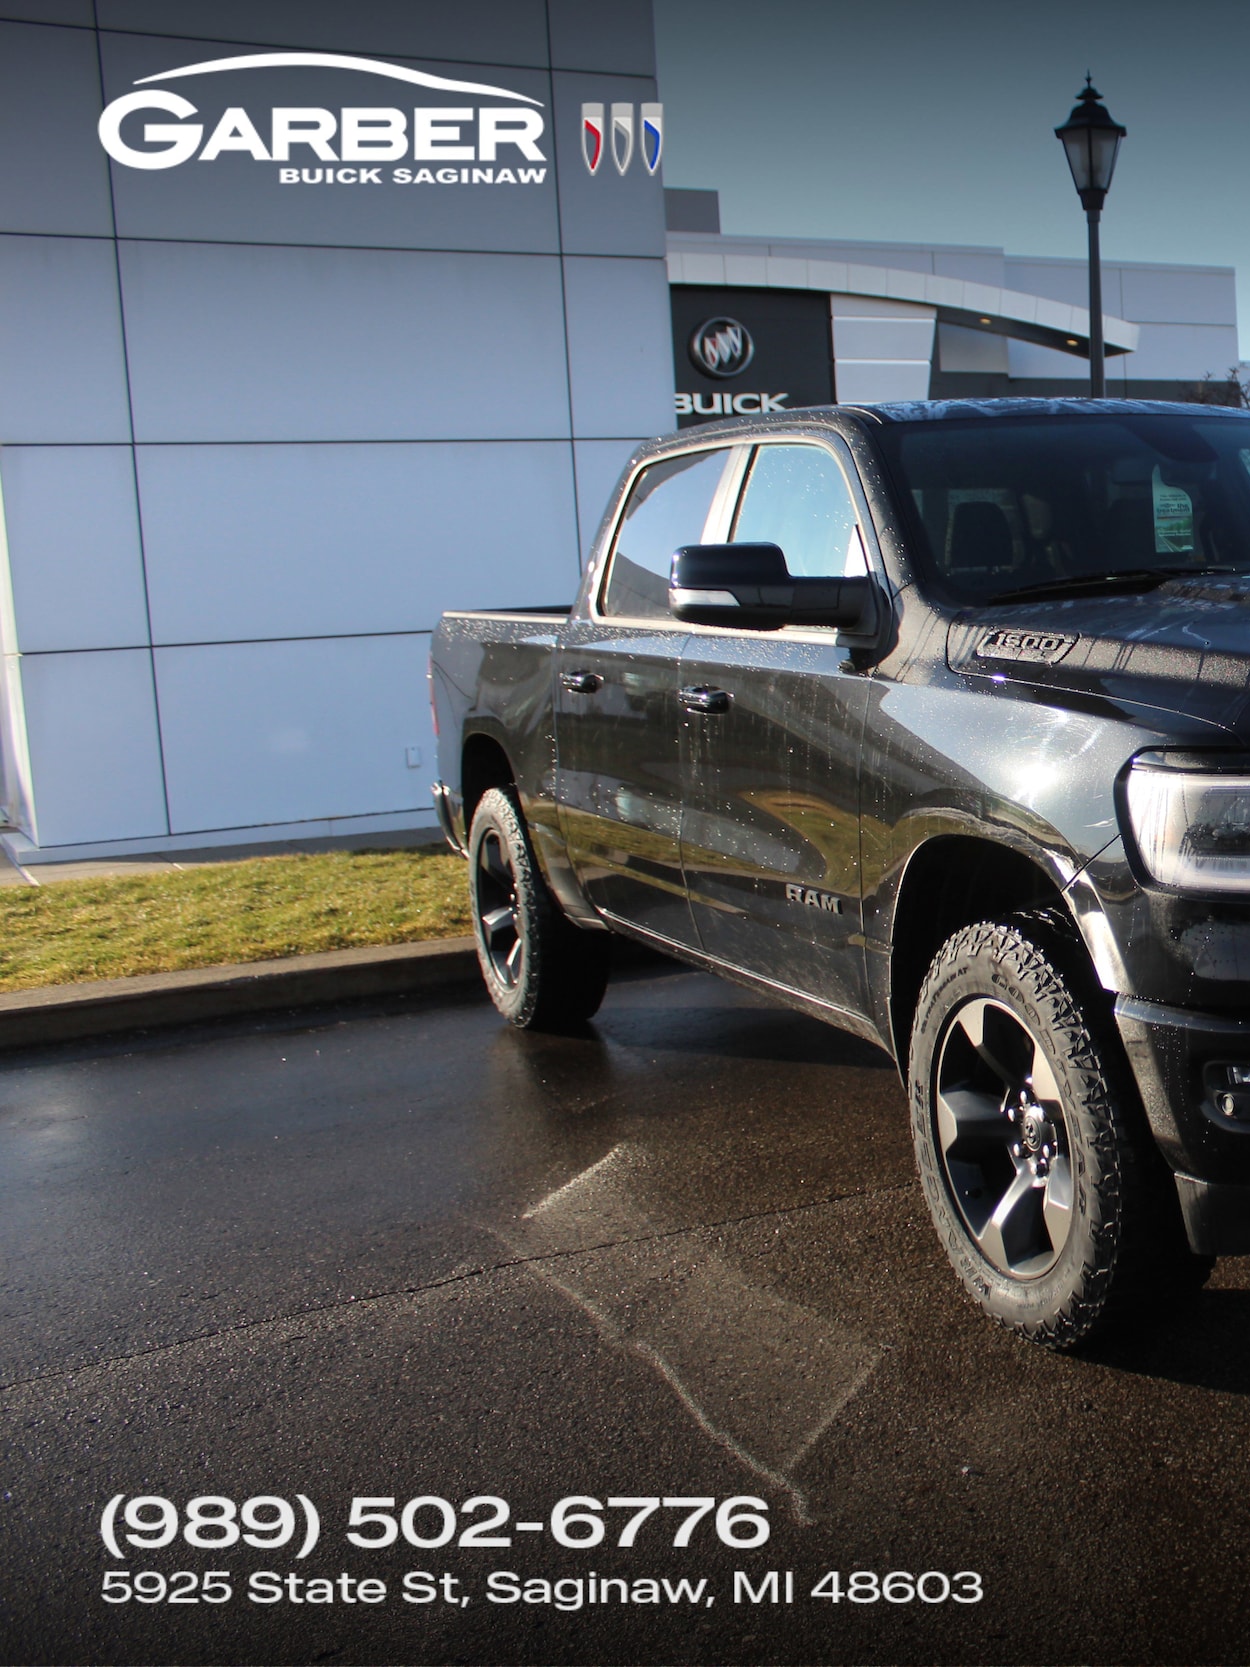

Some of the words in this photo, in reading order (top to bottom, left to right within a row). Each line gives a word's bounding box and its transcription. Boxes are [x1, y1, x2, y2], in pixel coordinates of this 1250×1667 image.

[674, 393, 789, 414] BUICK
[992, 631, 1061, 652] 1500
[785, 883, 843, 914] RAM
